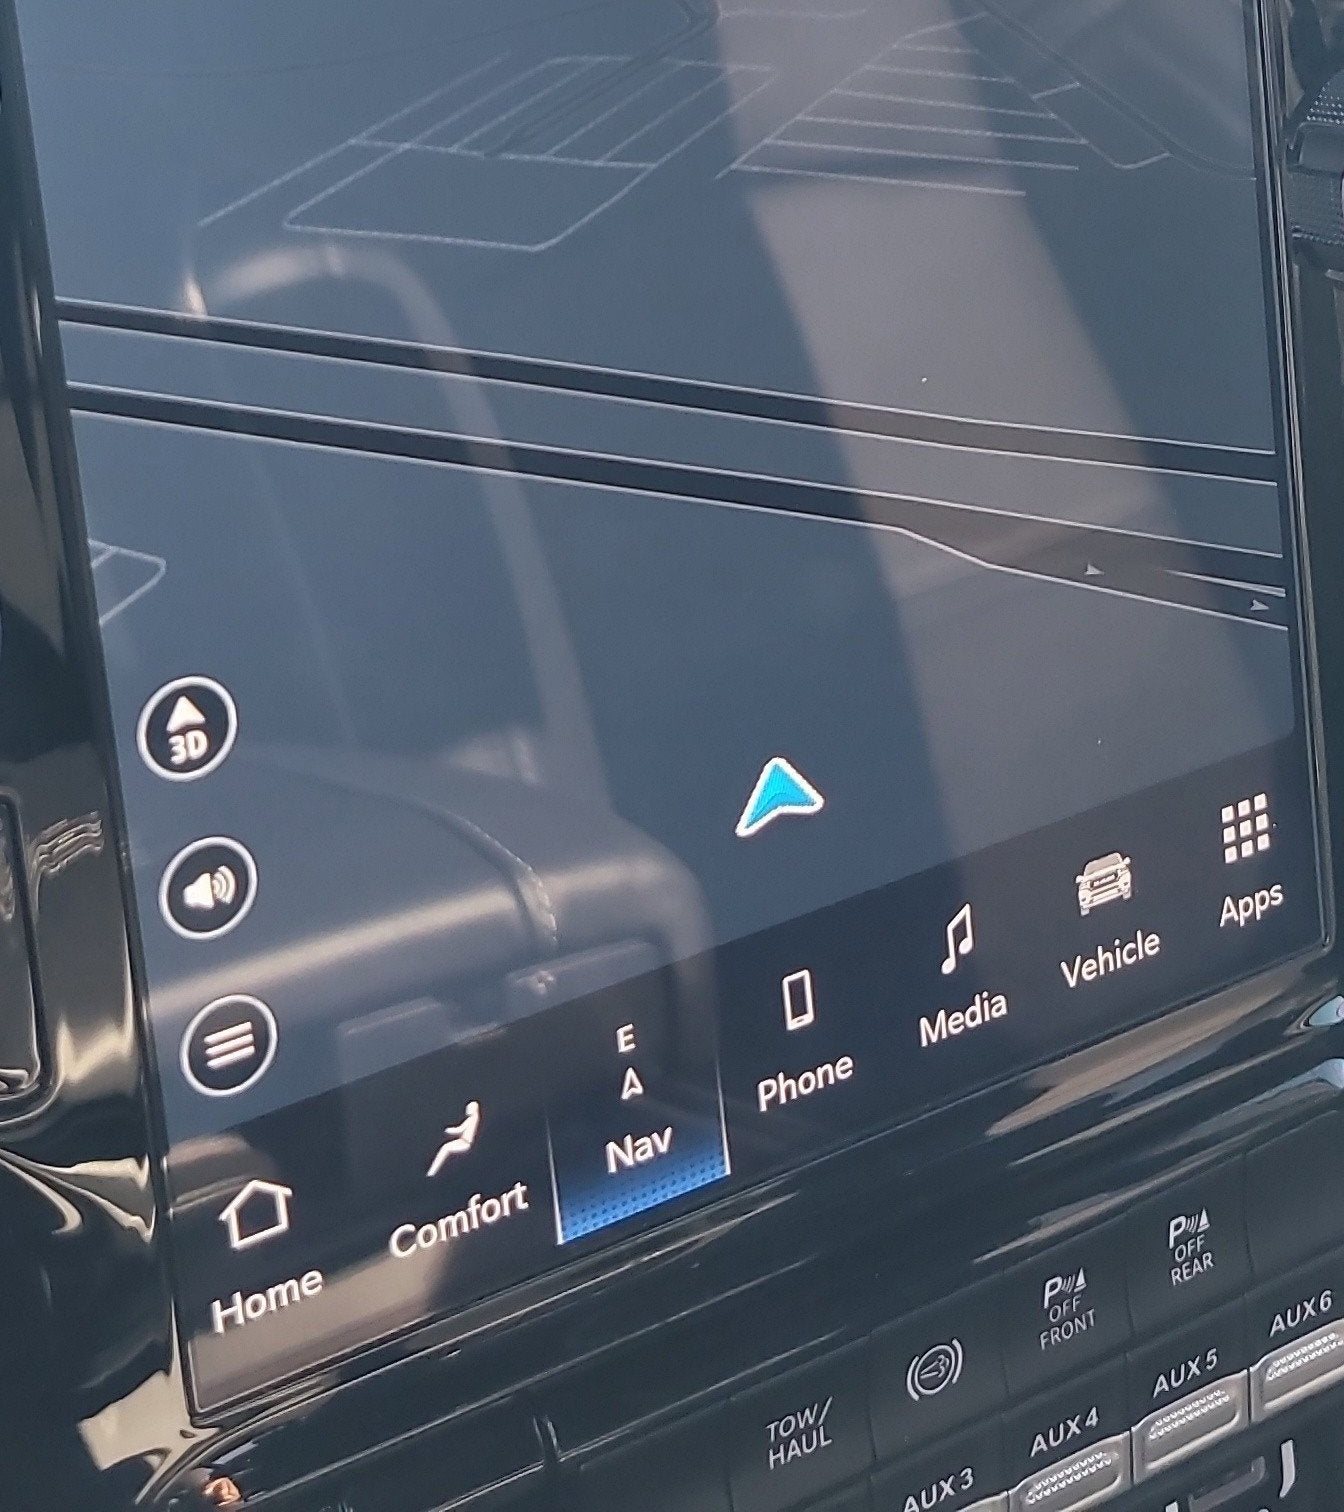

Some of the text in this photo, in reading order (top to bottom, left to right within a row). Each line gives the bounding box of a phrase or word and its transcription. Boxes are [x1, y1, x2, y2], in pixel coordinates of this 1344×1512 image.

[167, 728, 209, 765] 3D
[1218, 880, 1285, 928] Apps
[1059, 928, 1162, 989] Vehicle
[615, 1022, 637, 1054] E
[917, 989, 1009, 1048] Media
[757, 1053, 854, 1113] Phone
[604, 1125, 675, 1175] Nav
[387, 1180, 531, 1260] Comfort
[1170, 1251, 1215, 1287] REAR
[1174, 1233, 1206, 1263] OFF
[209, 1269, 325, 1336] Home
[1048, 1293, 1083, 1324] OFF
[1268, 1289, 1333, 1338] AUX 6
[1038, 1308, 1096, 1351] FRONT
[1151, 1347, 1219, 1399] AUX 5
[765, 1396, 834, 1444] TOW/
[1028, 1405, 1101, 1458] AUX 4
[767, 1424, 834, 1472] HAUL
[902, 1467, 975, 1512] AUX 3
